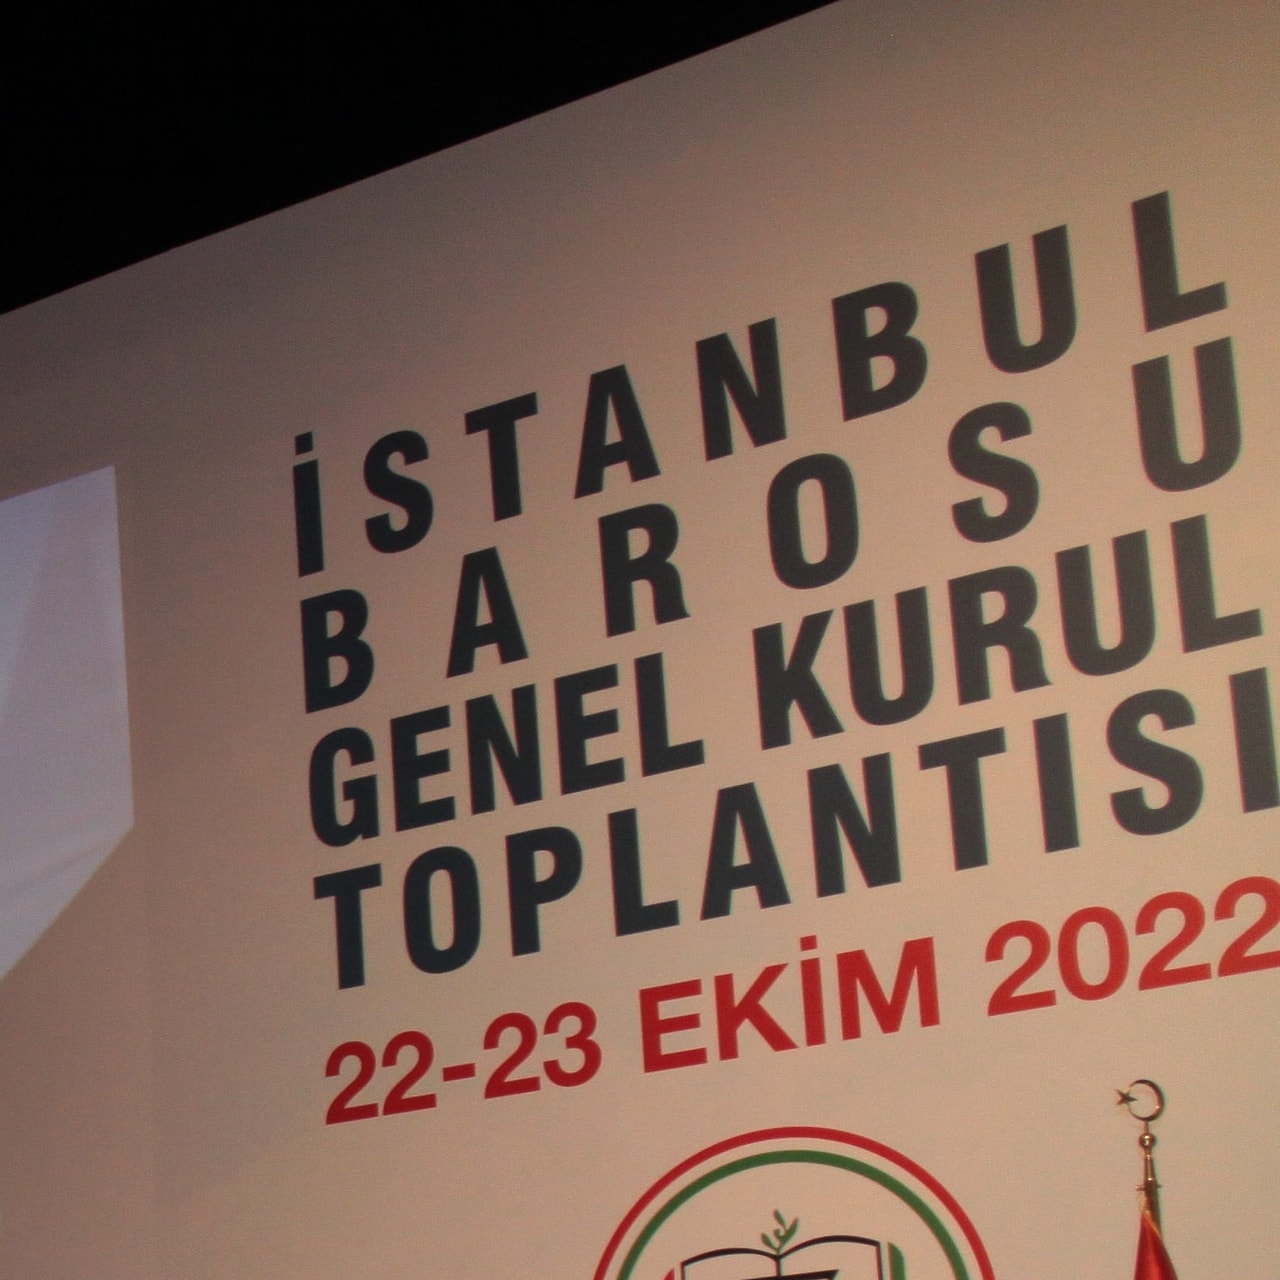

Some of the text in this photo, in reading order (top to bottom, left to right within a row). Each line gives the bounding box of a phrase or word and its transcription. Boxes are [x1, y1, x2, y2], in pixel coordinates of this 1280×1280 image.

[290, 189, 1228, 578] İSTANBUL
[299, 335, 1243, 714] BAROSU
[307, 513, 1264, 849] GENEL KURUL
[313, 667, 1280, 991] TOPLANTISI
[324, 875, 1280, 1126] 22-23 EKİM 2022
